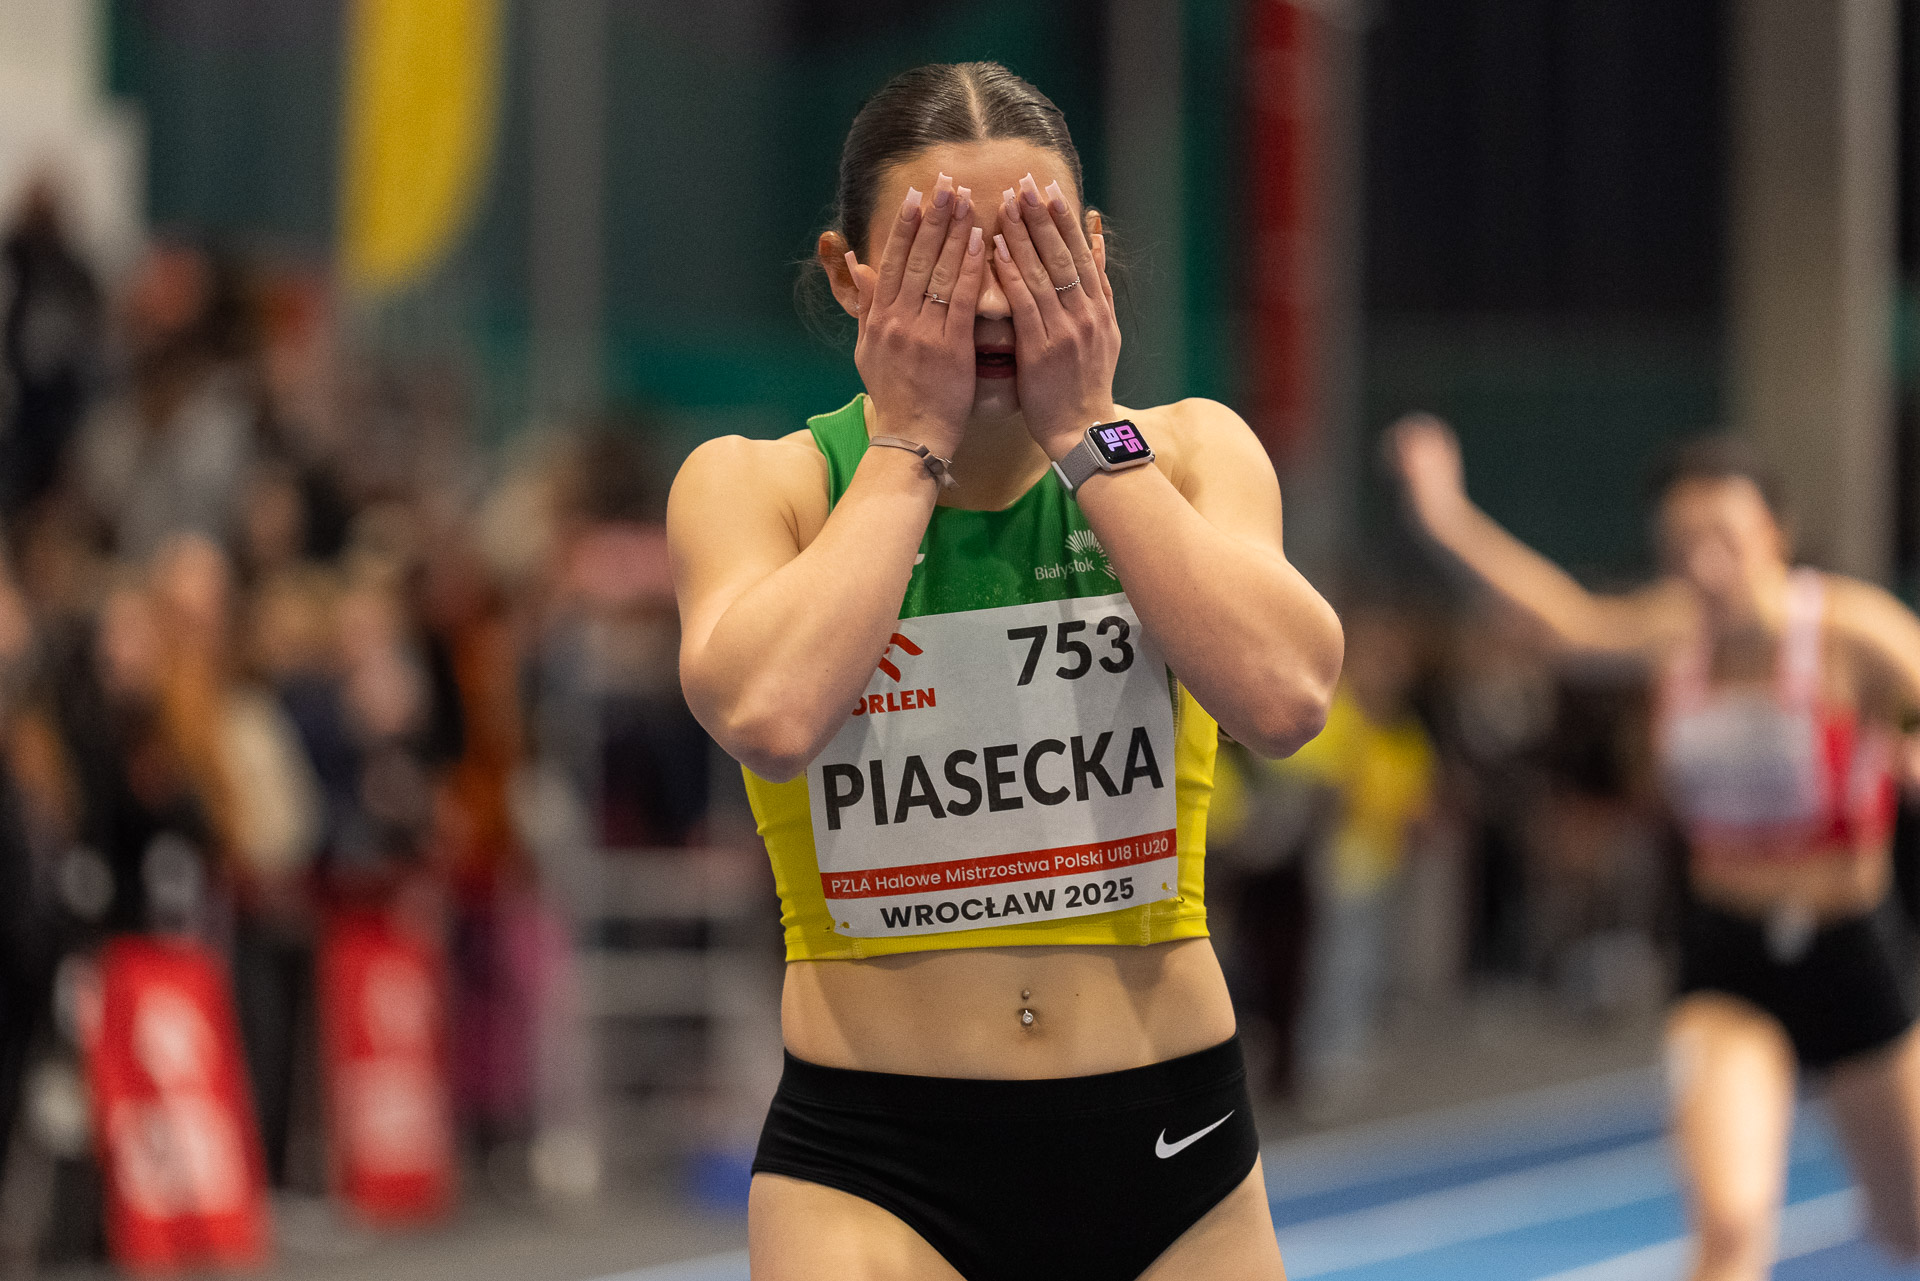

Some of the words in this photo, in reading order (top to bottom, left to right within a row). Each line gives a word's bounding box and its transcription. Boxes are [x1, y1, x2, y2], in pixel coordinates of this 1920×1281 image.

[1099, 428, 1124, 452] 16
[1115, 425, 1144, 454] 50
[1034, 557, 1095, 580] Białystok
[1007, 615, 1135, 687] 753
[822, 726, 1165, 831] PIASECKA
[831, 878, 871, 894] PZLA
[875, 873, 941, 891] Halowe
[945, 859, 1050, 883] Mistrzostwa
[1054, 849, 1104, 871] Polski
[1107, 845, 1132, 863] U18
[1135, 843, 1140, 858] i
[1143, 837, 1169, 856] U20
[879, 888, 1056, 929] WROCŁAW
[1064, 876, 1135, 909] 2025
